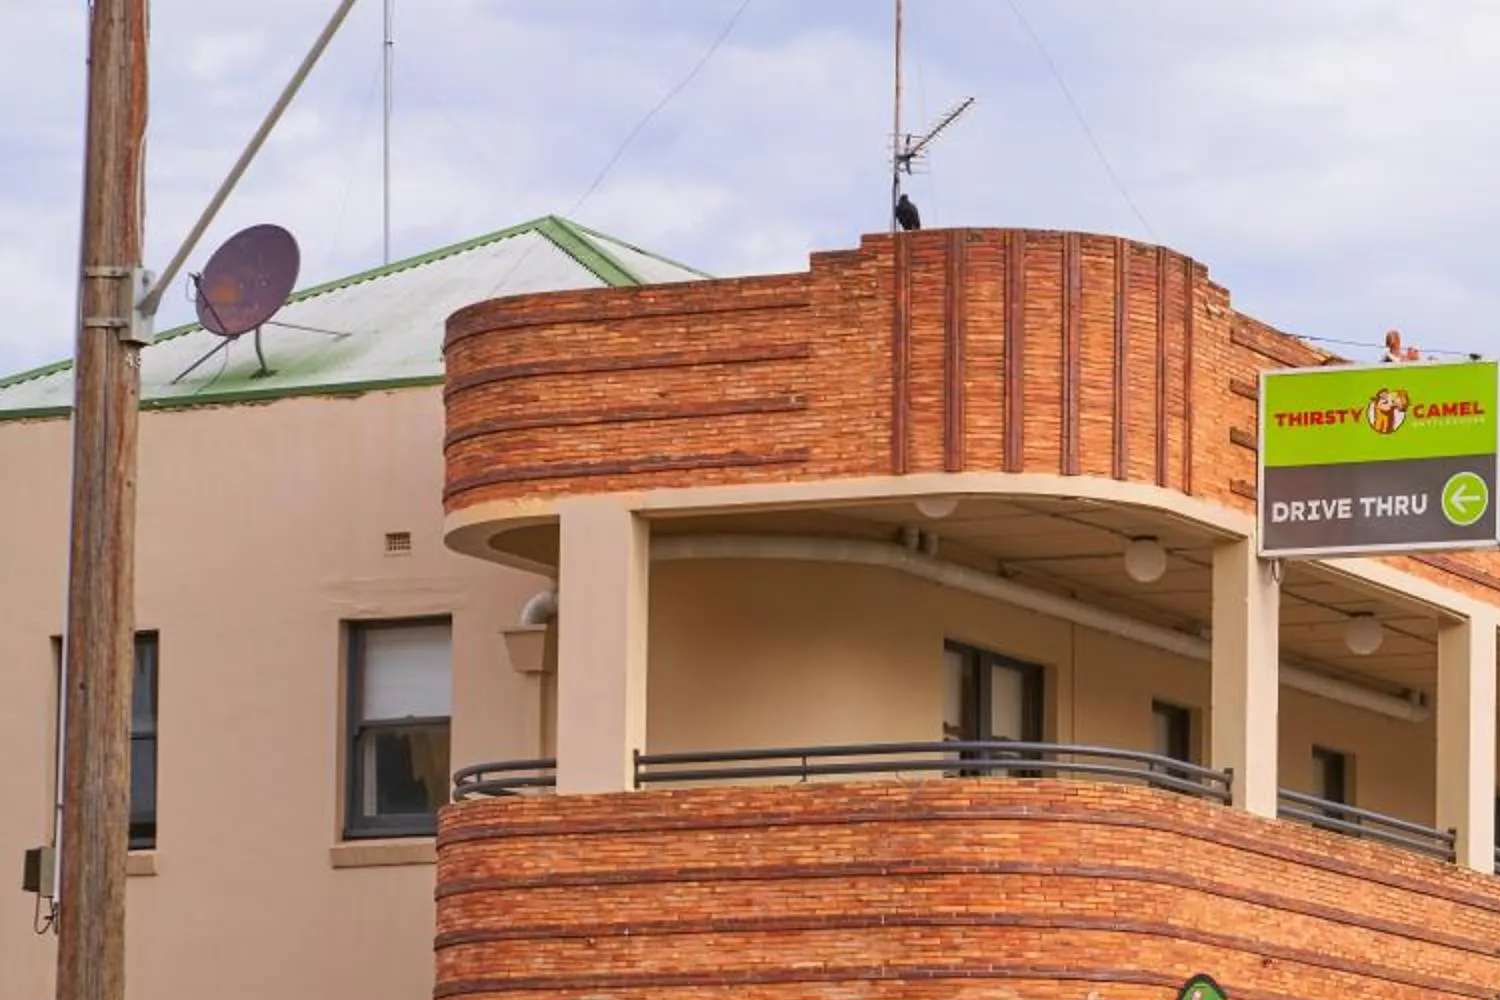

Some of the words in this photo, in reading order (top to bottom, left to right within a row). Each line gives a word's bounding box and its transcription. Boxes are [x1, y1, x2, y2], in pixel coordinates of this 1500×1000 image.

[1273, 407, 1363, 427] THIRSTY
[1412, 401, 1485, 419] CAMEL
[1271, 498, 1353, 523] DRIVE
[1360, 493, 1428, 518] THRU
